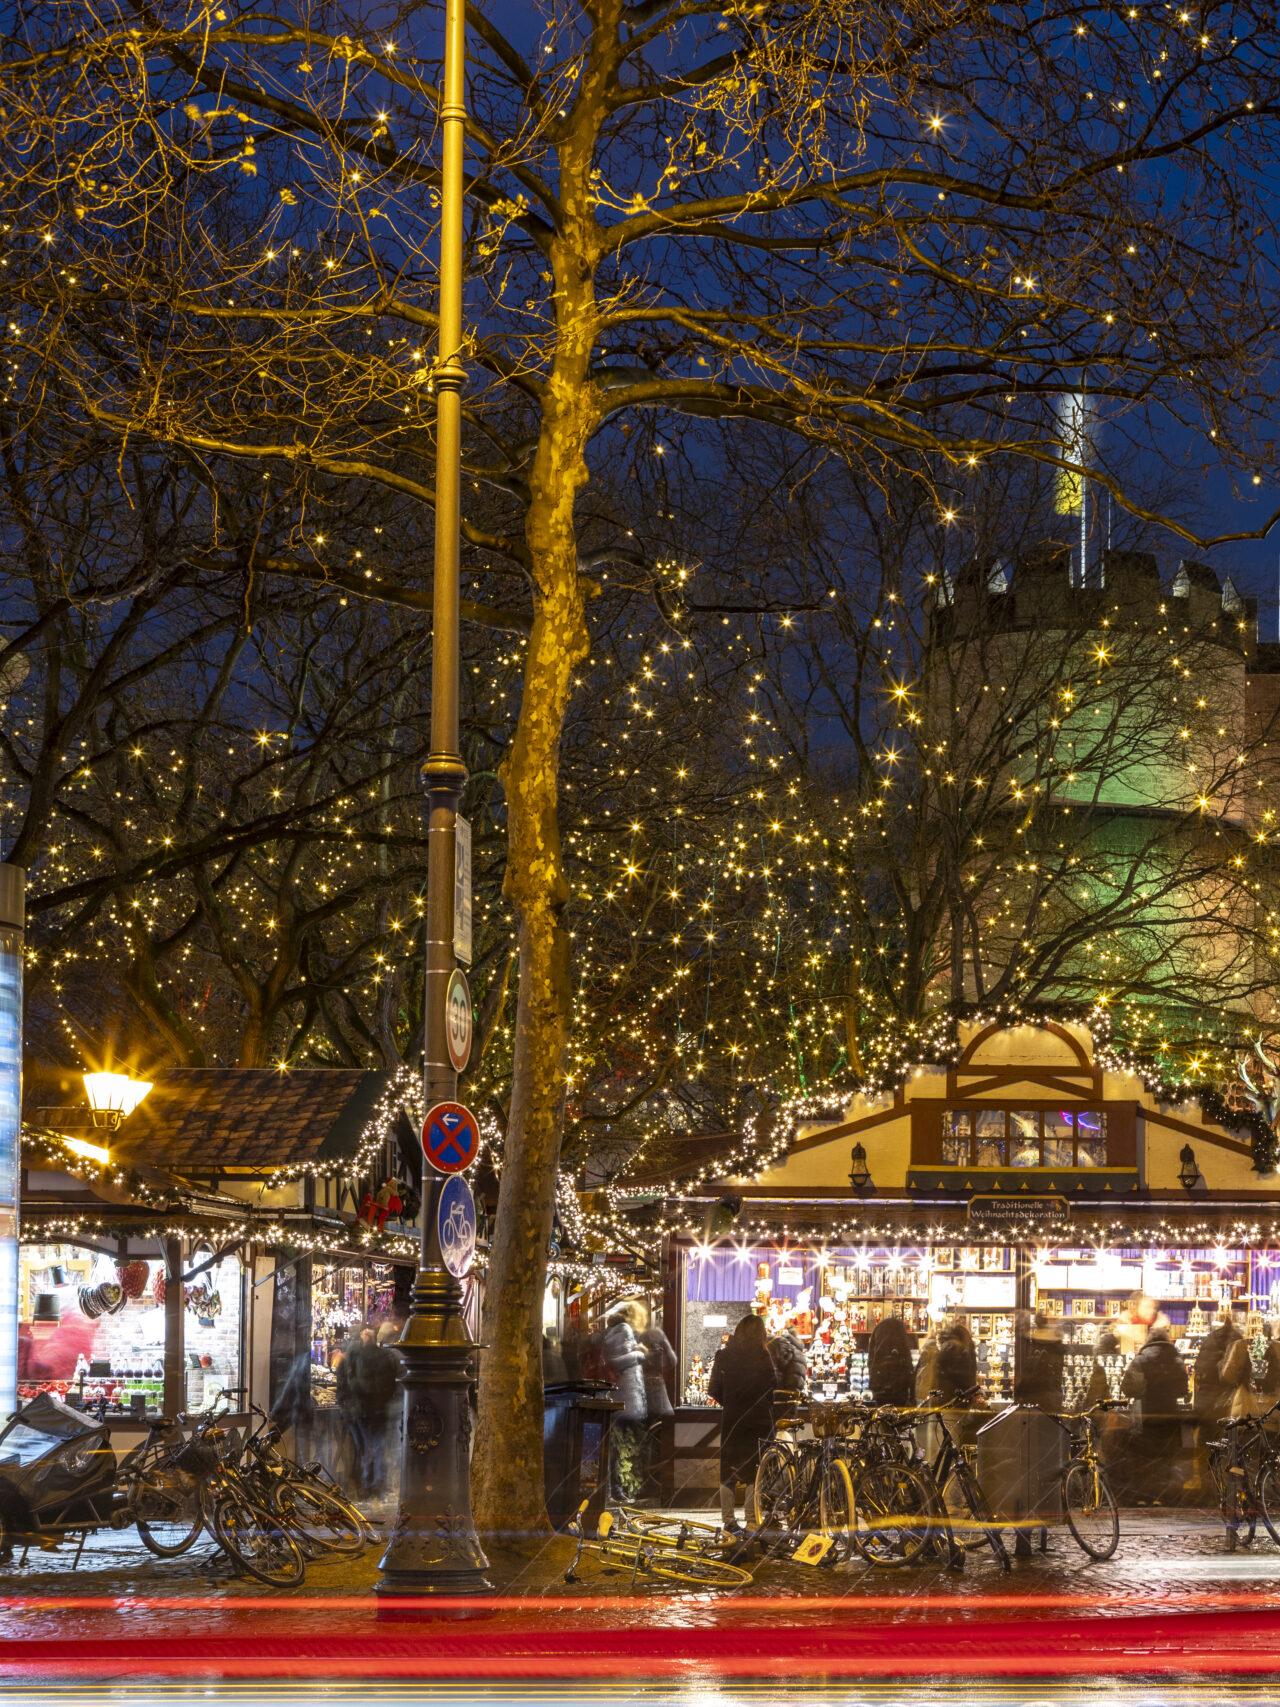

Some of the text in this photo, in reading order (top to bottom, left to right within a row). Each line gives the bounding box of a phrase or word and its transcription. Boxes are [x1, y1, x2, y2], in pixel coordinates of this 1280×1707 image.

[452, 997, 467, 1043] 30
[991, 1201, 1044, 1209] Traditionelle
[970, 1210, 1065, 1219] Weihnachtsdekoration
